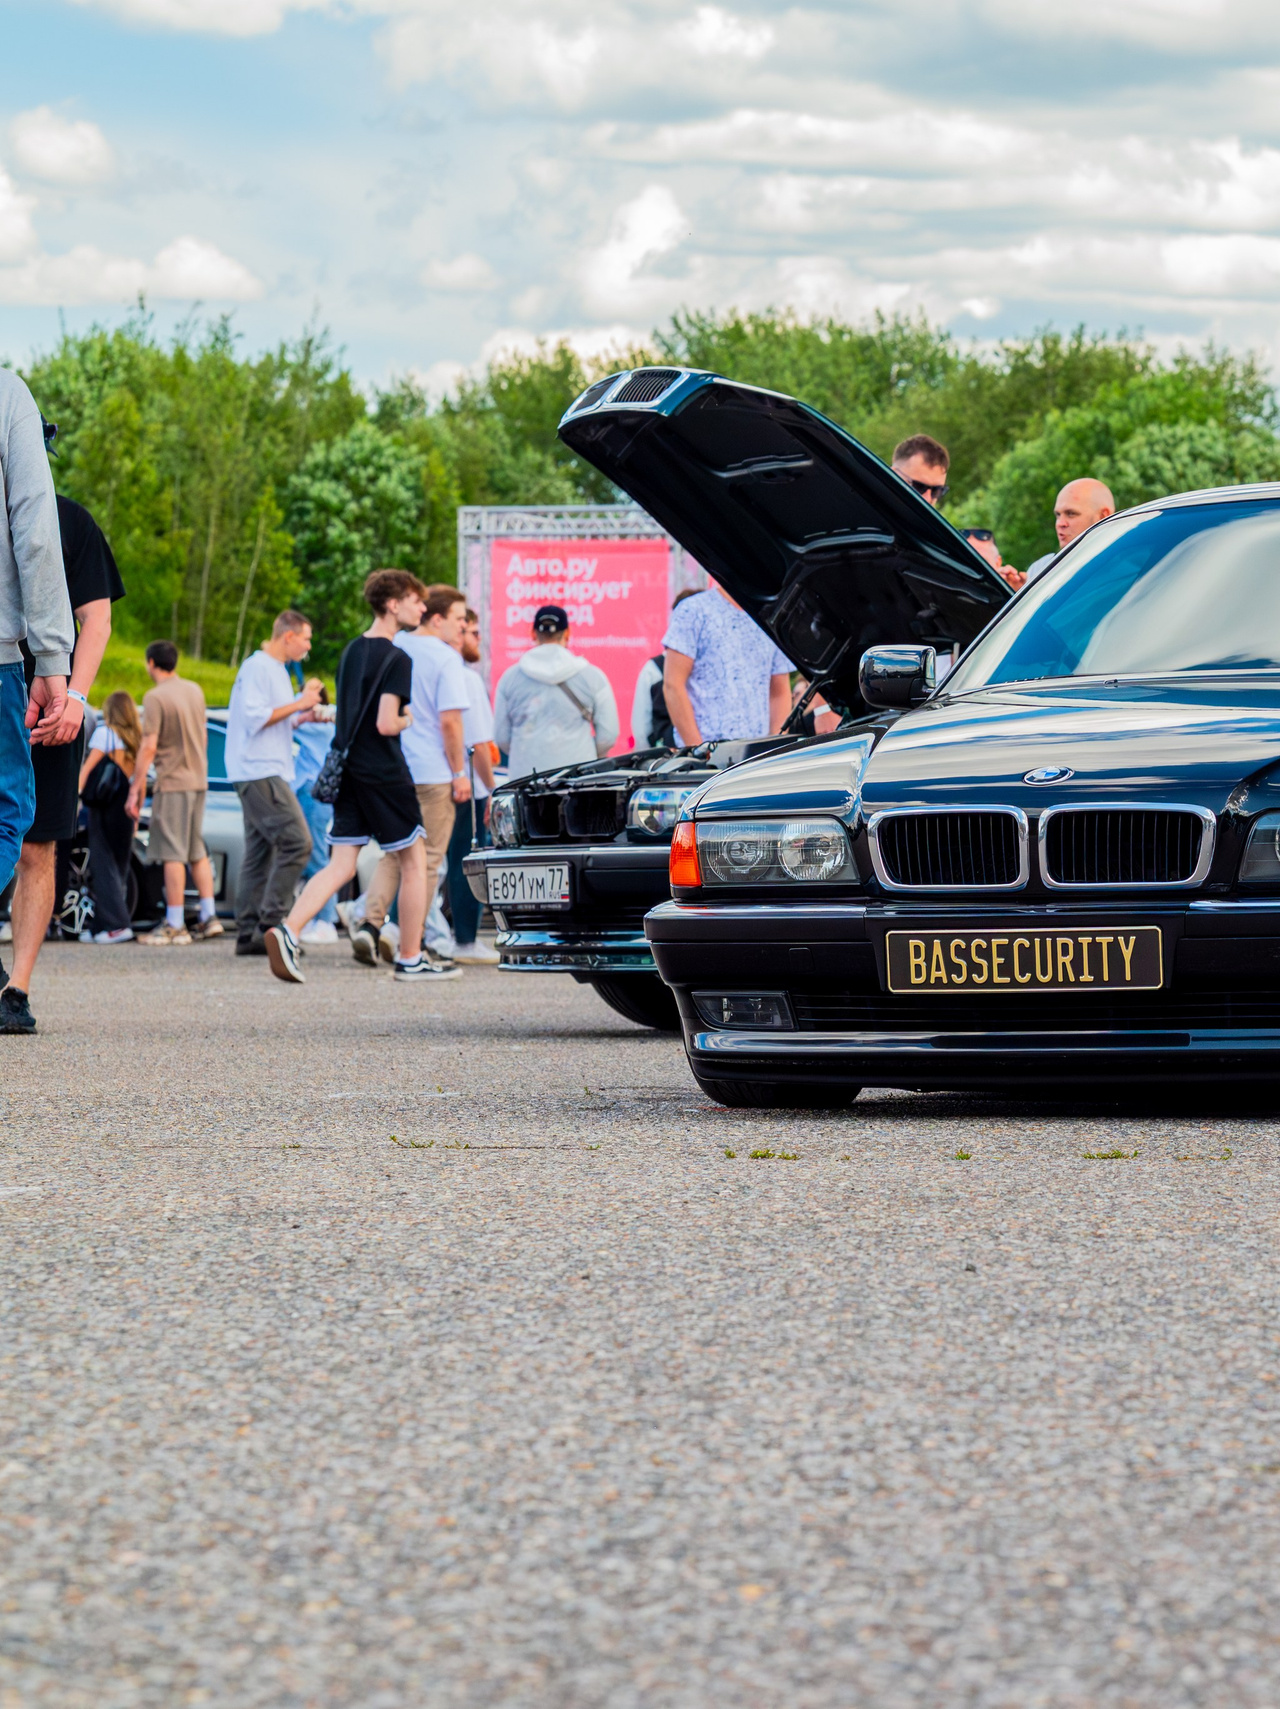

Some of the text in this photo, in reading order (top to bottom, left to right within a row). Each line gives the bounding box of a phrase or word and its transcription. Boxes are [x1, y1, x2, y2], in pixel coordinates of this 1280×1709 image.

[506, 554, 598, 581] Авто.ру
[506, 577, 633, 604] фиксирует
[548, 868, 564, 890] 77
[909, 936, 1136, 984] BASSECURITY
